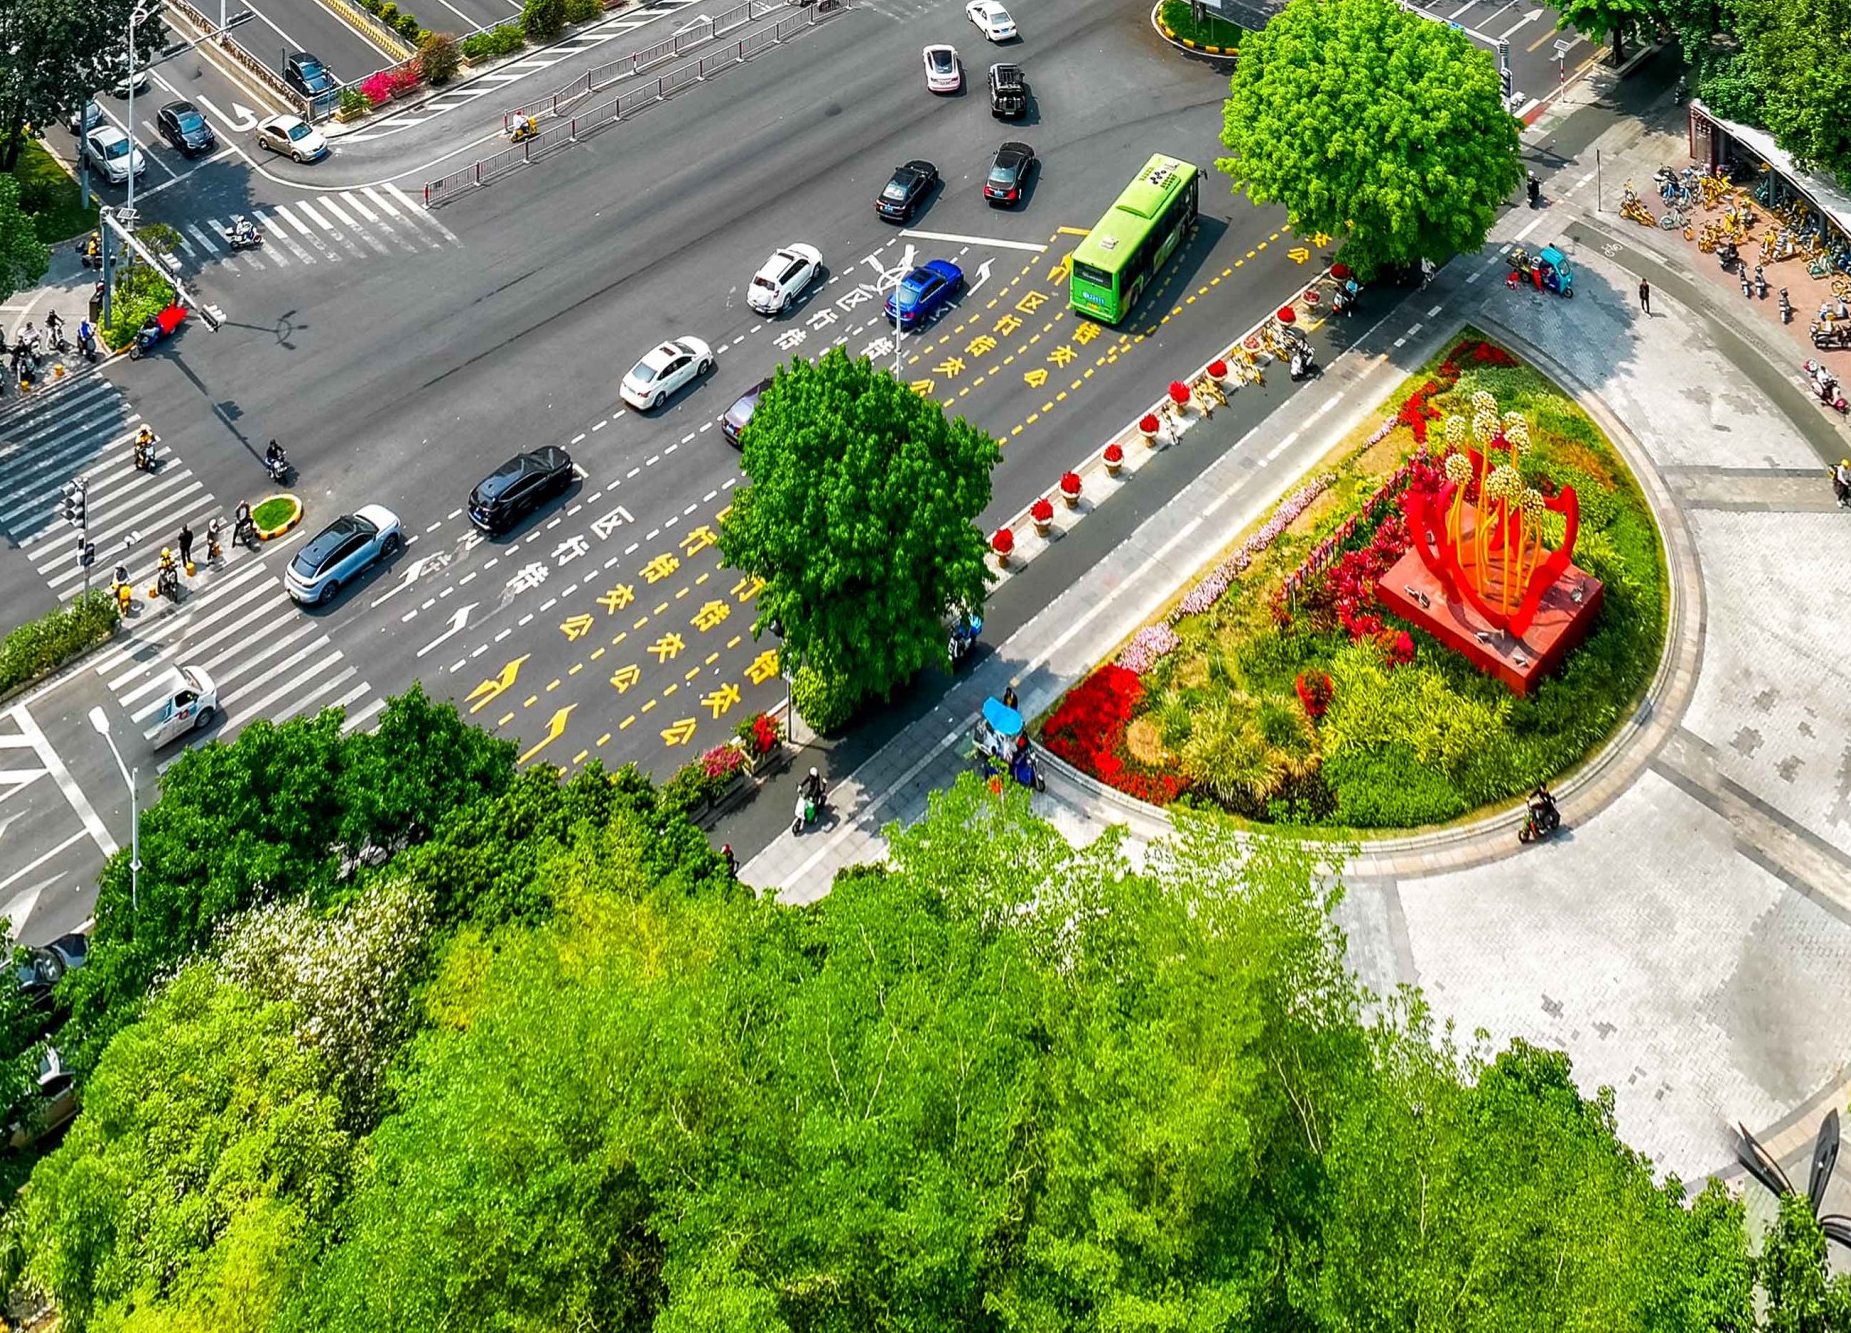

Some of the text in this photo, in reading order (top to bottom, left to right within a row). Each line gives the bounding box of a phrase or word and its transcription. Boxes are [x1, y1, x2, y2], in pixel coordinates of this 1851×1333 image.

[773, 286, 877, 351] 待行区
[506, 505, 635, 595] 待行区
[559, 505, 734, 641] 公交待行
